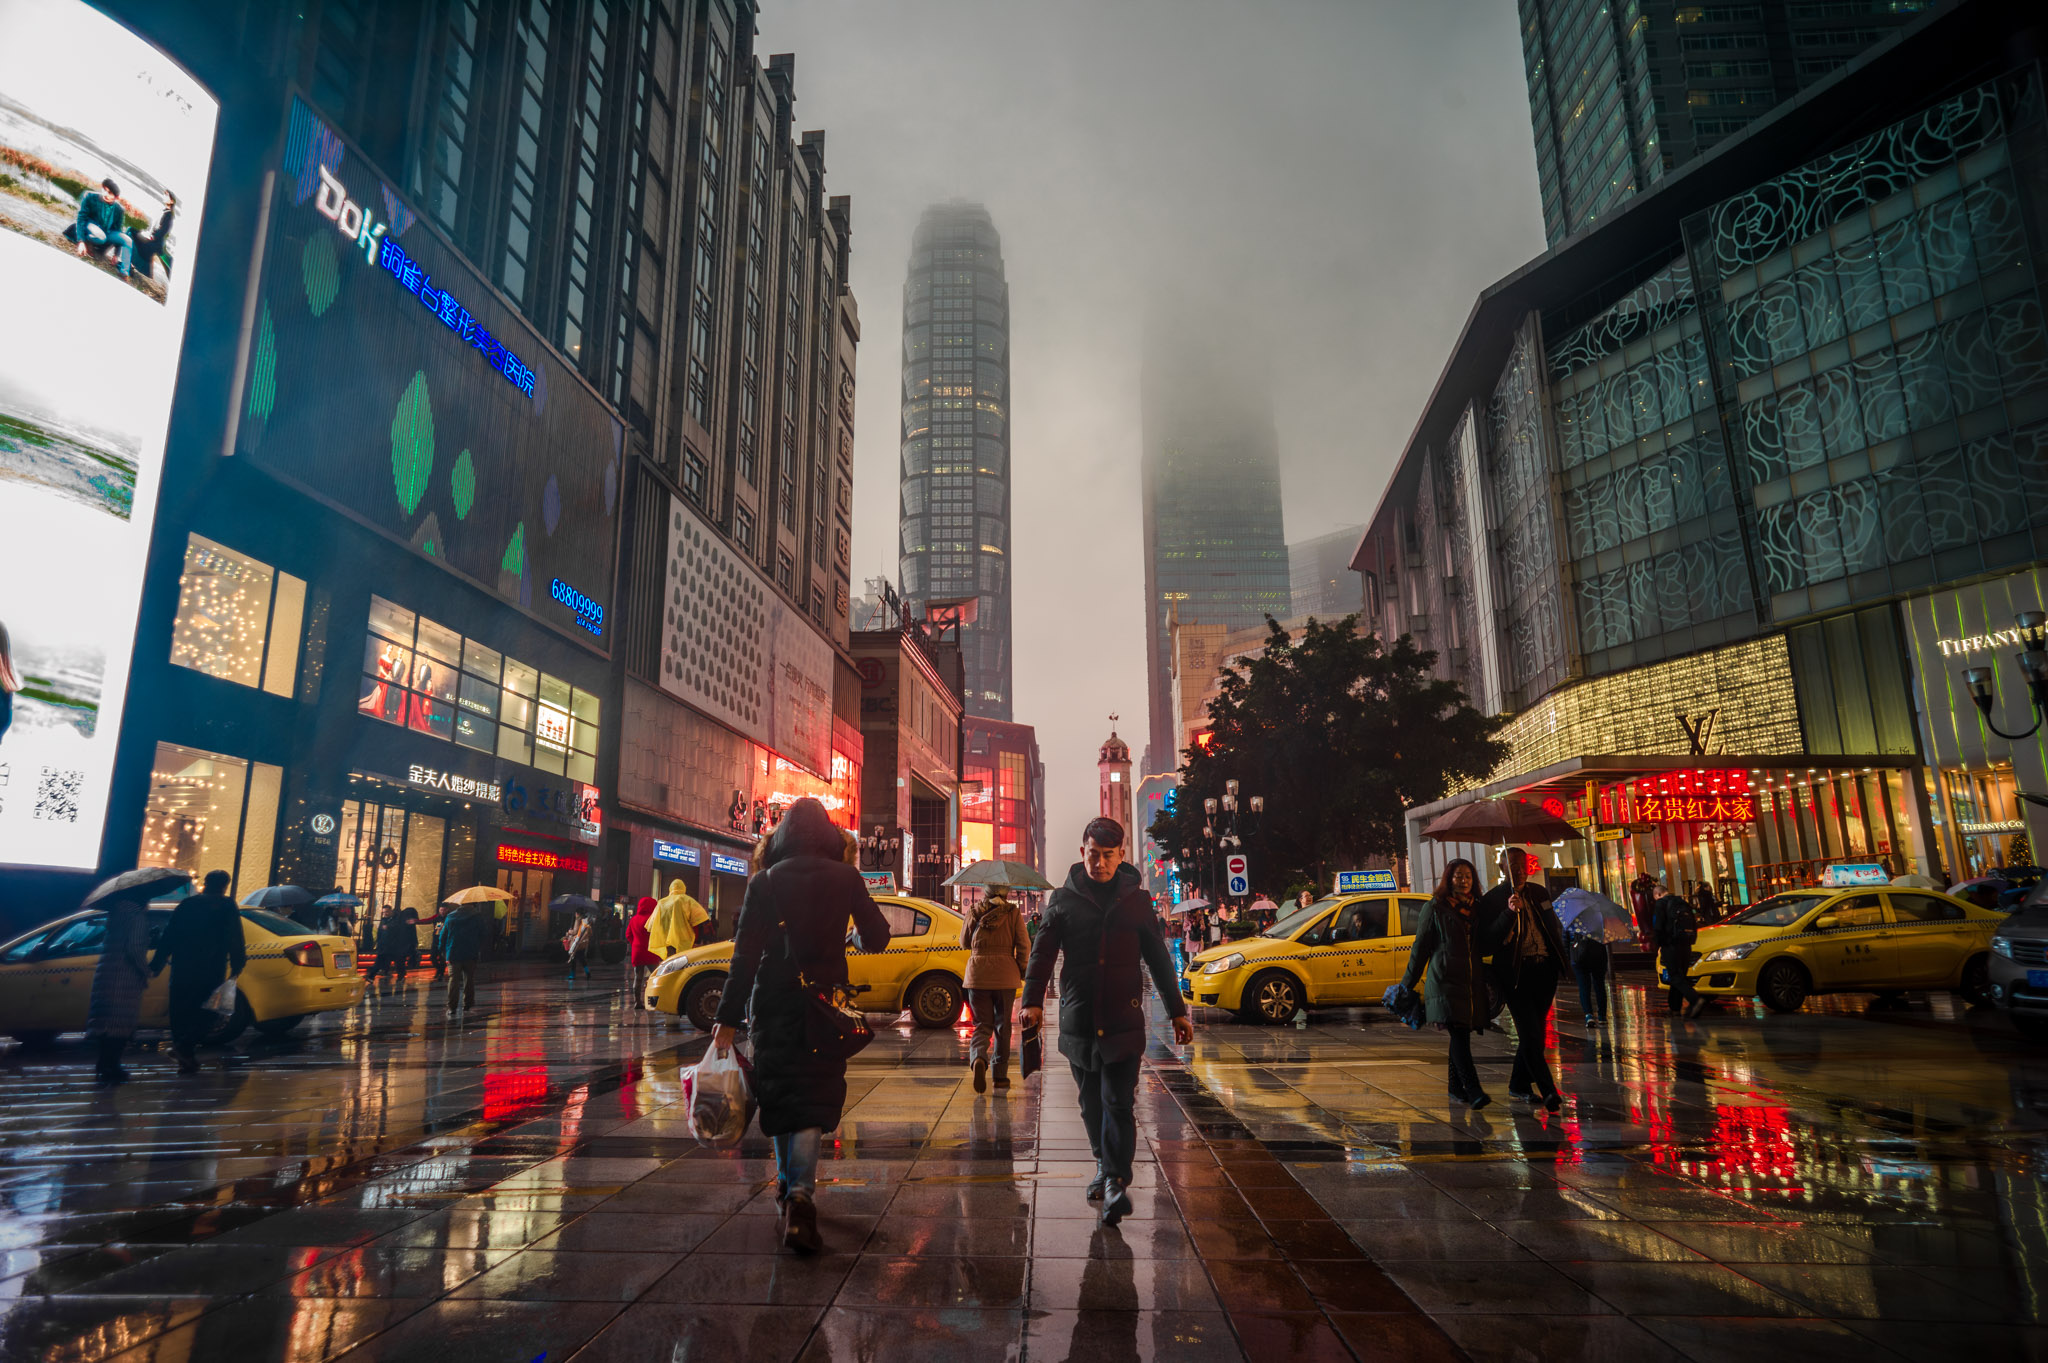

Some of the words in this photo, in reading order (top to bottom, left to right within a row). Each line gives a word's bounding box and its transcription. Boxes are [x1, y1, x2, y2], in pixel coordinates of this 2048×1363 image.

[380, 236, 535, 399] 铜雀台整形美容医院
[551, 577, 604, 625] 68809999
[1936, 627, 2020, 658] TIFFANY
[408, 763, 501, 802] 金夫人婚纱摄影
